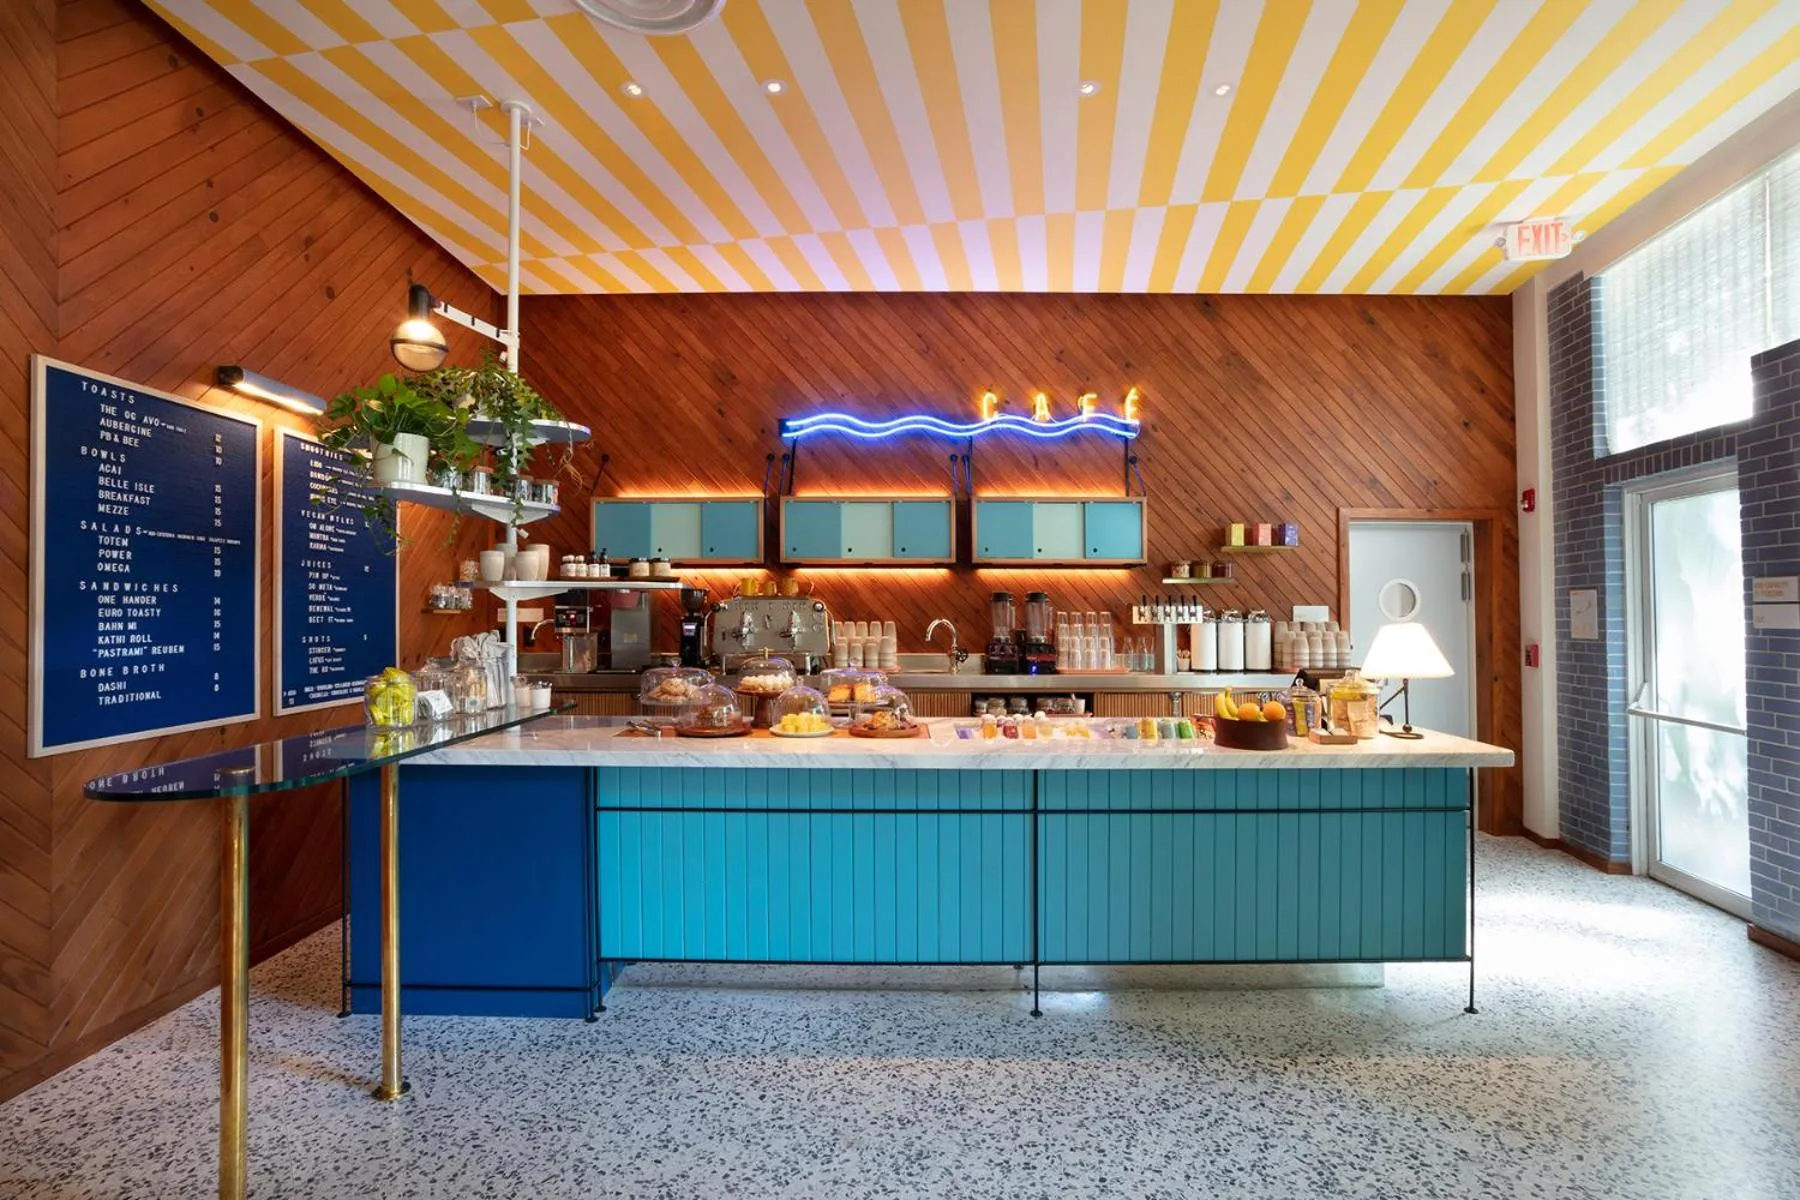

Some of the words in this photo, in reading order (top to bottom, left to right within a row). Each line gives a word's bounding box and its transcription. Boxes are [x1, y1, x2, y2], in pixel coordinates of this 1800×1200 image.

[1517, 220, 1563, 256] EXIT
[81, 381, 135, 404] TOASTS
[100, 403, 118, 416] THE
[983, 387, 1139, 423] CAFE
[122, 436, 141, 448] BEE
[80, 445, 126, 463] BOWLS
[98, 463, 121, 475] ACAI
[98, 476, 129, 490] BELLE
[134, 482, 155, 494] ISLE
[98, 489, 151, 506] BREAKFAST
[97, 503, 129, 516] MEZZE
[98, 549, 132, 560] POWER
[97, 561, 131, 574] OMEGA
[300, 559, 332, 569] JUICES
[79, 580, 179, 593] SANDWICHES
[97, 595, 117, 605] ONE
[122, 595, 157, 605] HANDER
[97, 607, 124, 618] EURO
[127, 607, 162, 618] TOASTY
[97, 621, 124, 632] BAHN
[127, 621, 138, 631] MI
[97, 635, 126, 645] KATHI
[130, 633, 153, 643] ROLL
[151, 644, 185, 655] REUBEN
[80, 666, 114, 679] BONE
[122, 662, 166, 676] BROTH
[97, 681, 128, 693] DASHI
[97, 690, 162, 706] TRADITIONAL
